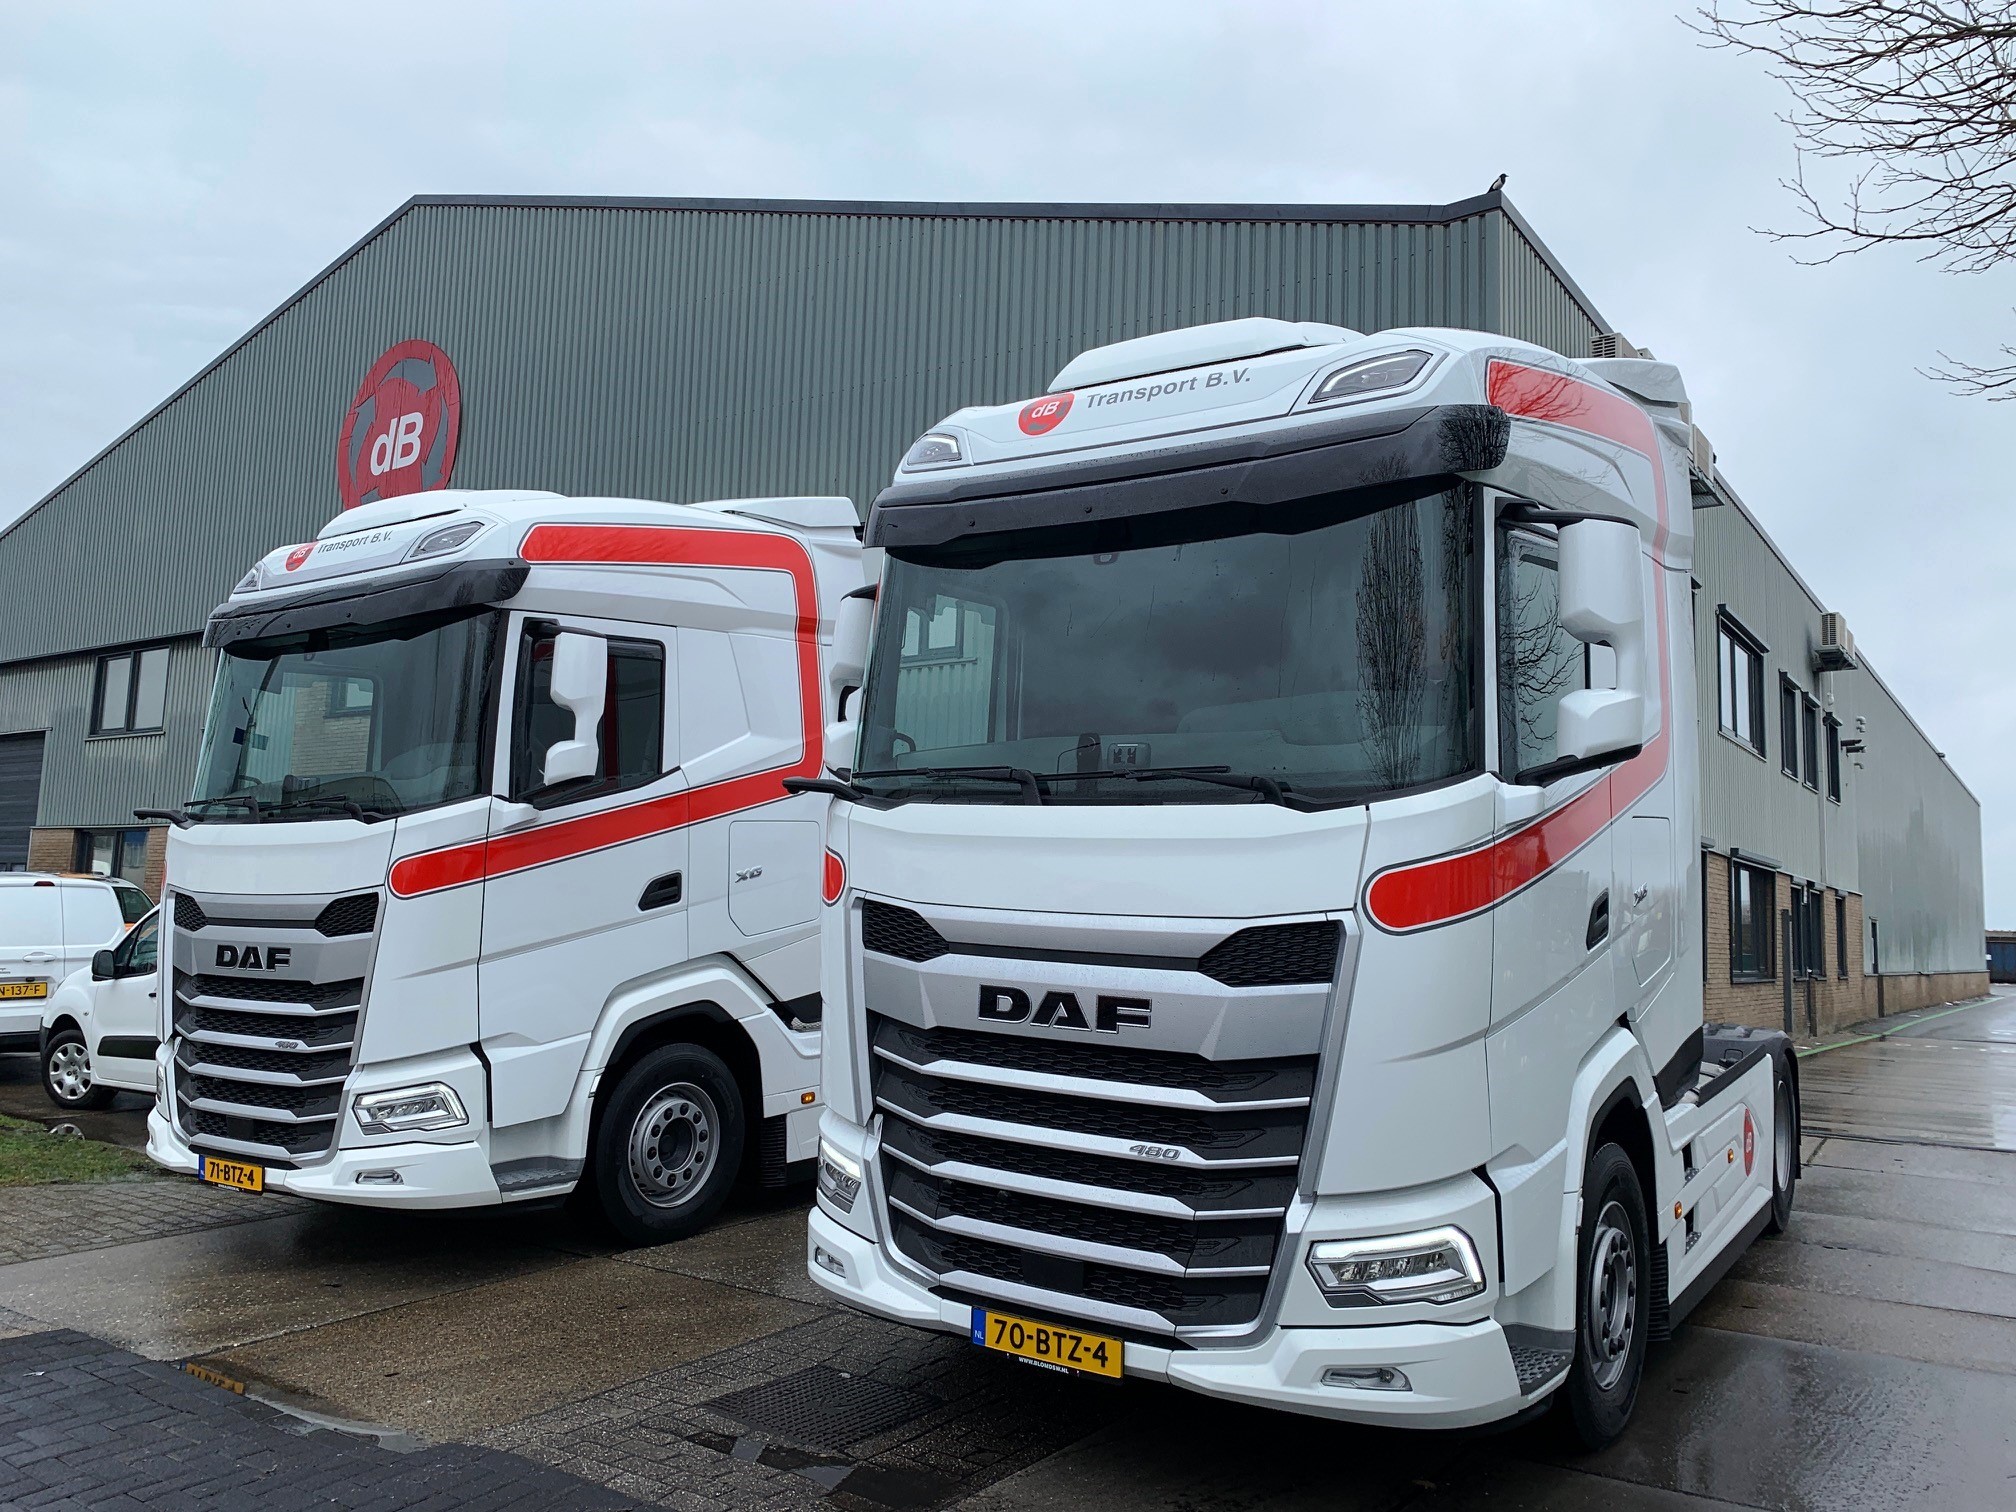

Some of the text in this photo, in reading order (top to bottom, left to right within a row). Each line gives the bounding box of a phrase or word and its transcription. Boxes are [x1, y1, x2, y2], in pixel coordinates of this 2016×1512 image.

[1031, 367, 1251, 419] dB Transport B.V.
[370, 411, 424, 476] dB
[317, 534, 370, 554] Transport
[370, 529, 394, 544] B.V.
[215, 944, 292, 972] DAF
[977, 983, 1153, 1034] DAF
[1129, 1143, 1181, 1161] 480
[209, 1161, 255, 1187] 71-BTZ-4
[974, 1318, 1109, 1368] NL 70-BTZ-4
